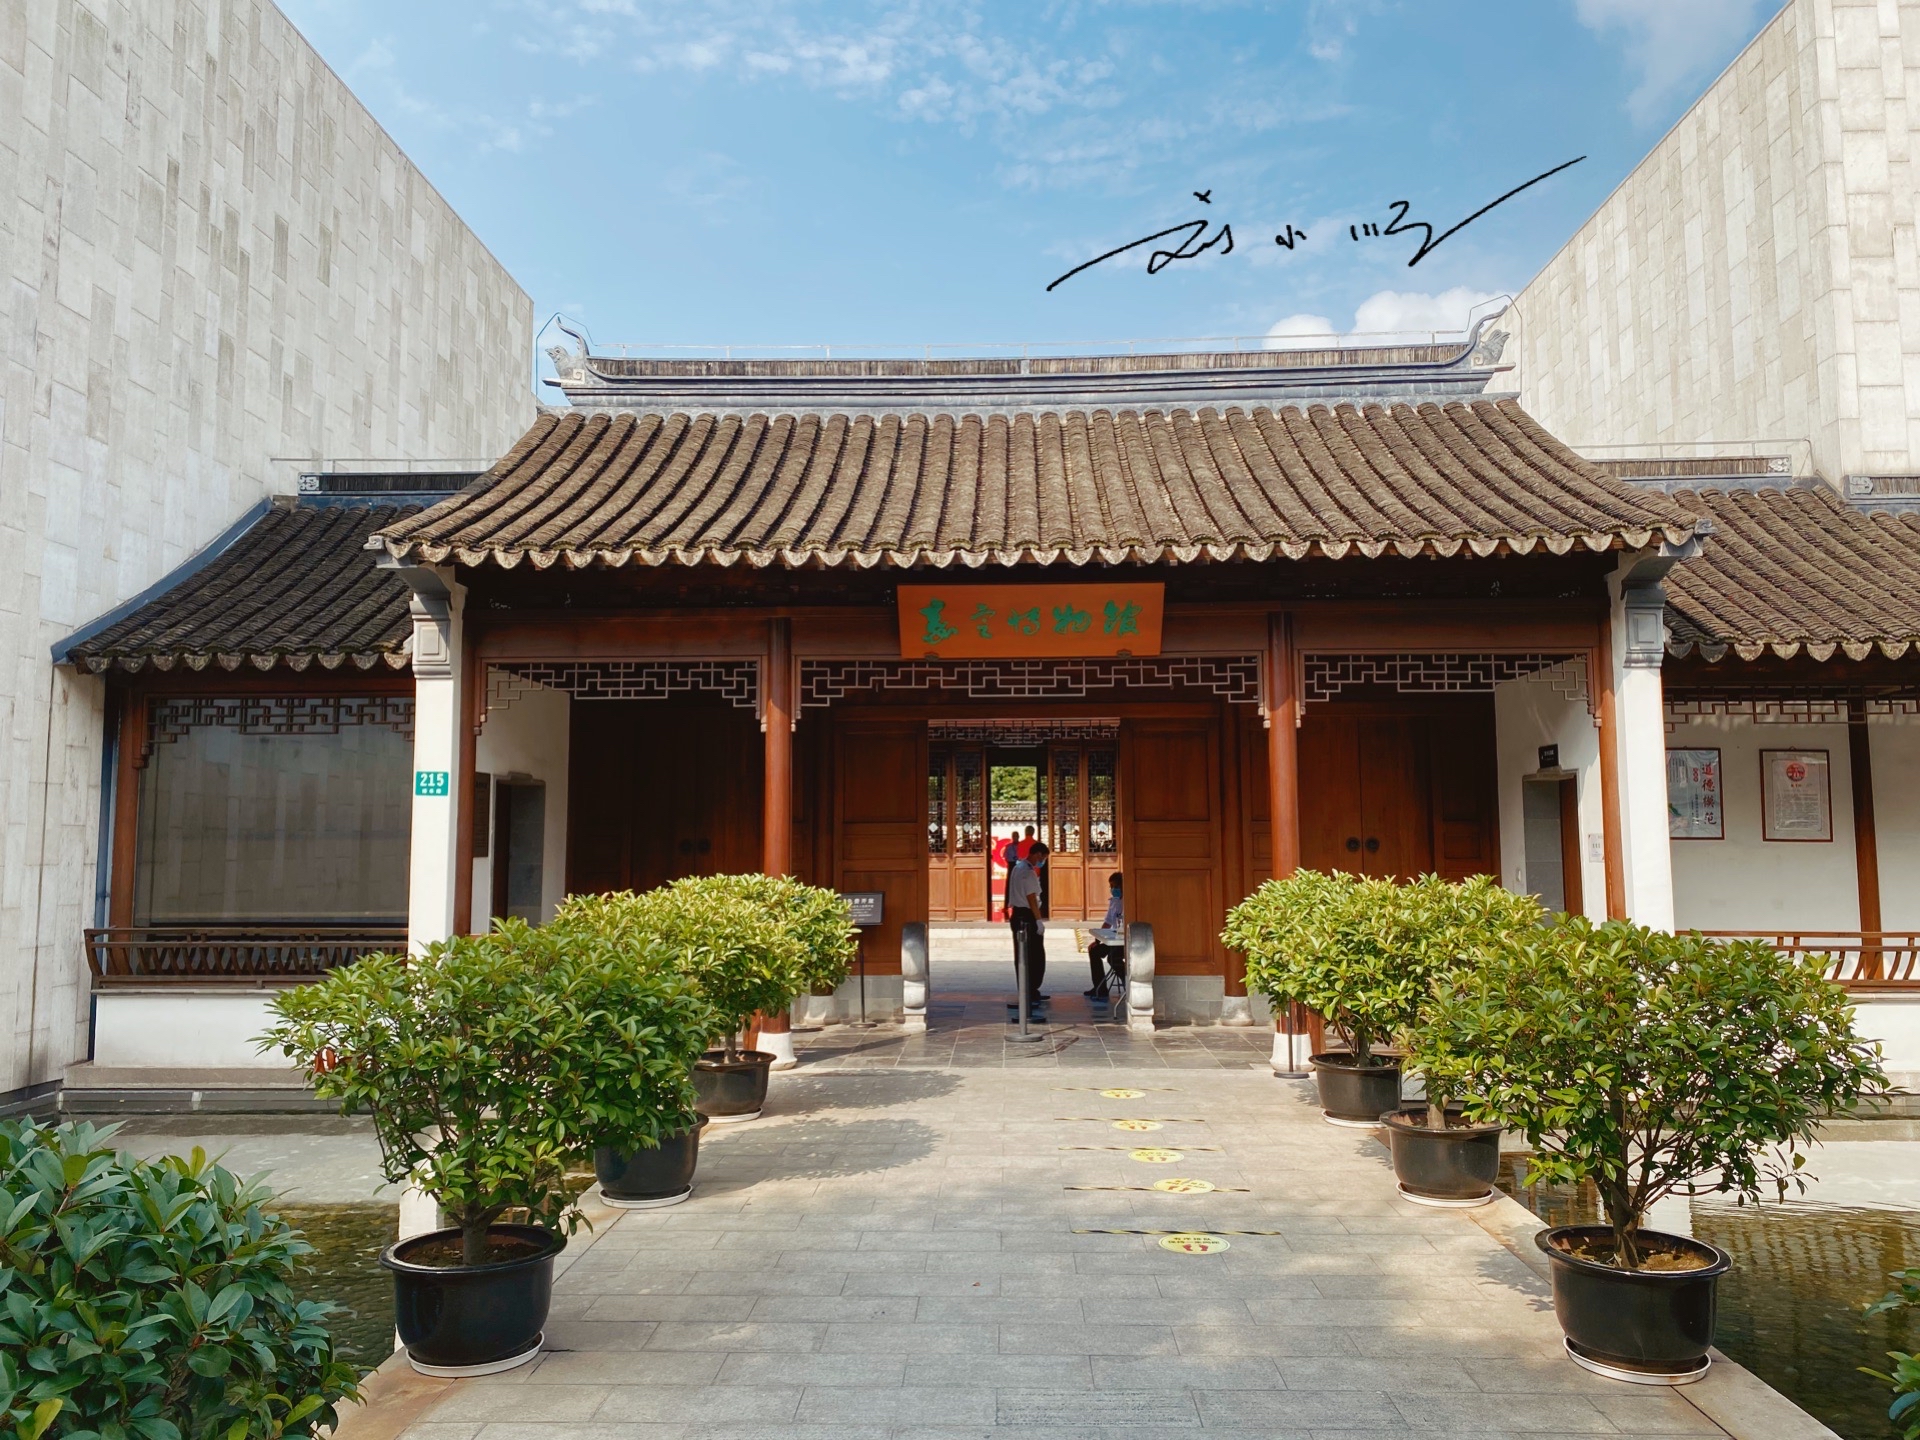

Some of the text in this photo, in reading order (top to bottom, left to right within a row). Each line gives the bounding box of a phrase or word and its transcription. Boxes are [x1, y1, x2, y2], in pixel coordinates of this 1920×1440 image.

[420, 773, 444, 787] 215
[1701, 762, 1717, 825] 道德模范
